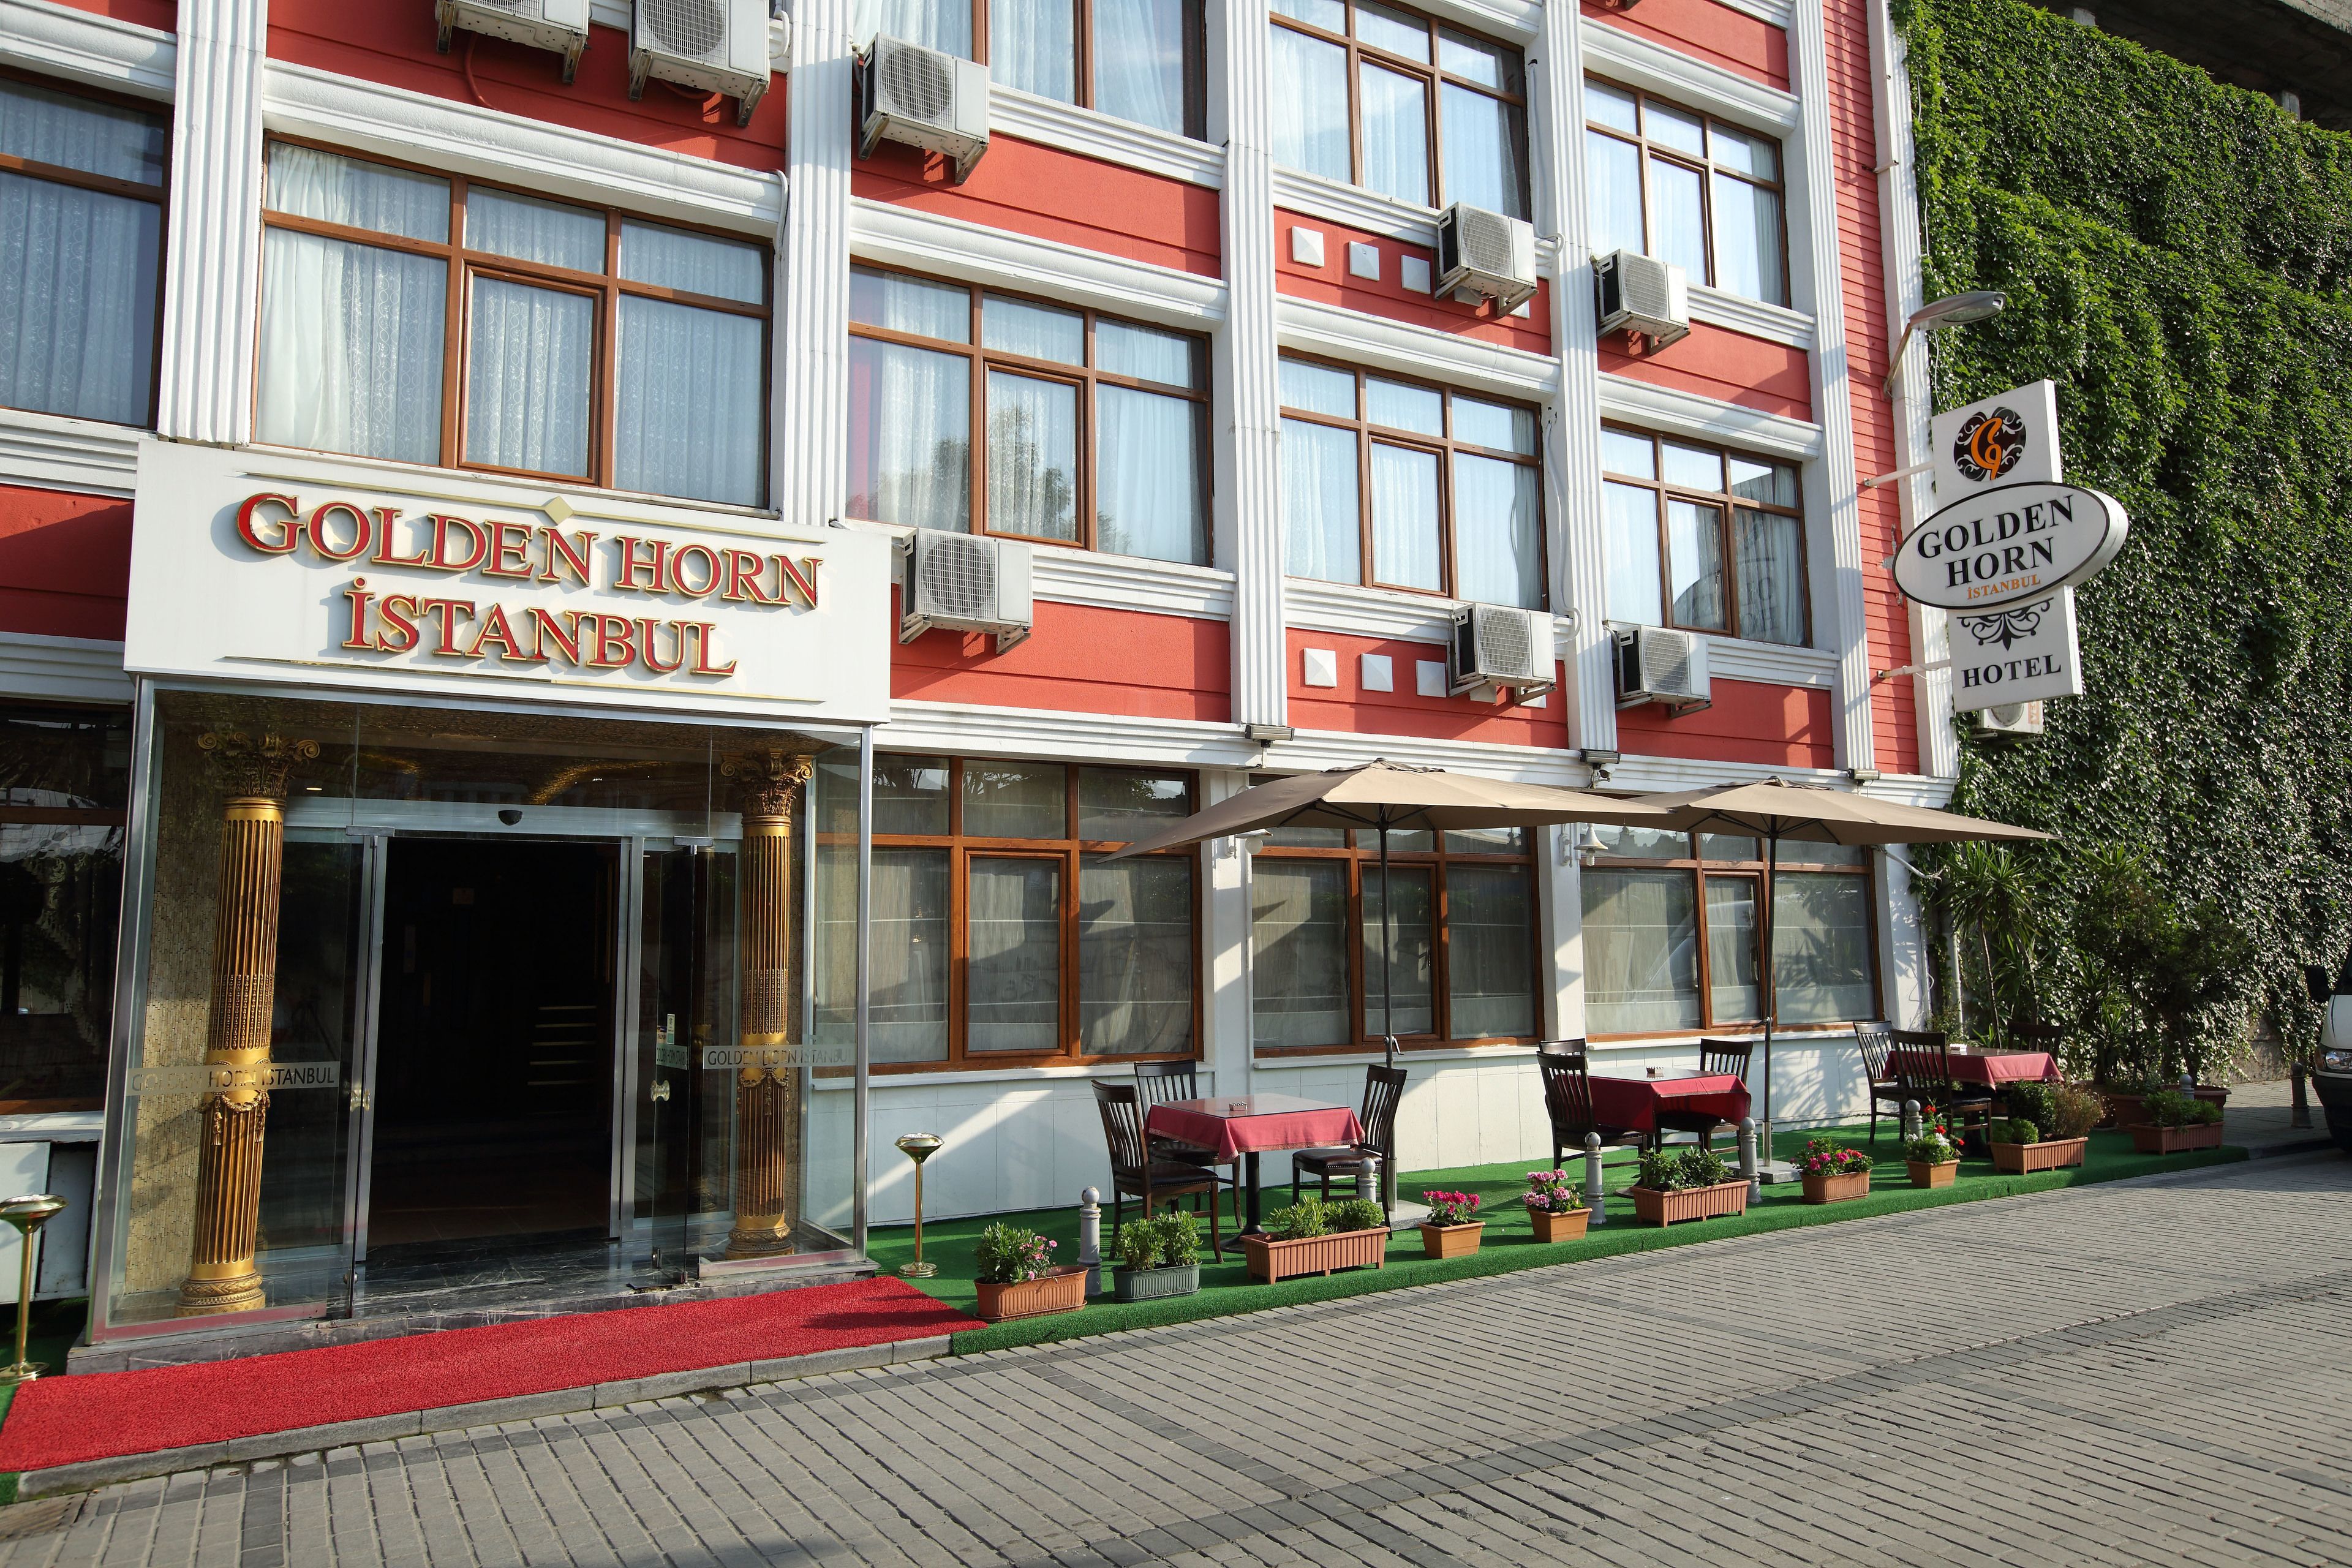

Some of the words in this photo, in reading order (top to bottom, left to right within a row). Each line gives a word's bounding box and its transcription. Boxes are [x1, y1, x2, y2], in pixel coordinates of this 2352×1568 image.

[236, 492, 599, 587] GOLDEN
[615, 534, 824, 609] HORN
[1917, 494, 2074, 559] GOLDEN
[1945, 537, 2054, 589] HORN
[1967, 574, 2041, 600] İSTANBUL
[342, 576, 738, 677] İSTANBUL
[1962, 654, 2062, 688] HOTEL
[262, 1066, 334, 1085] İSTANBUL
